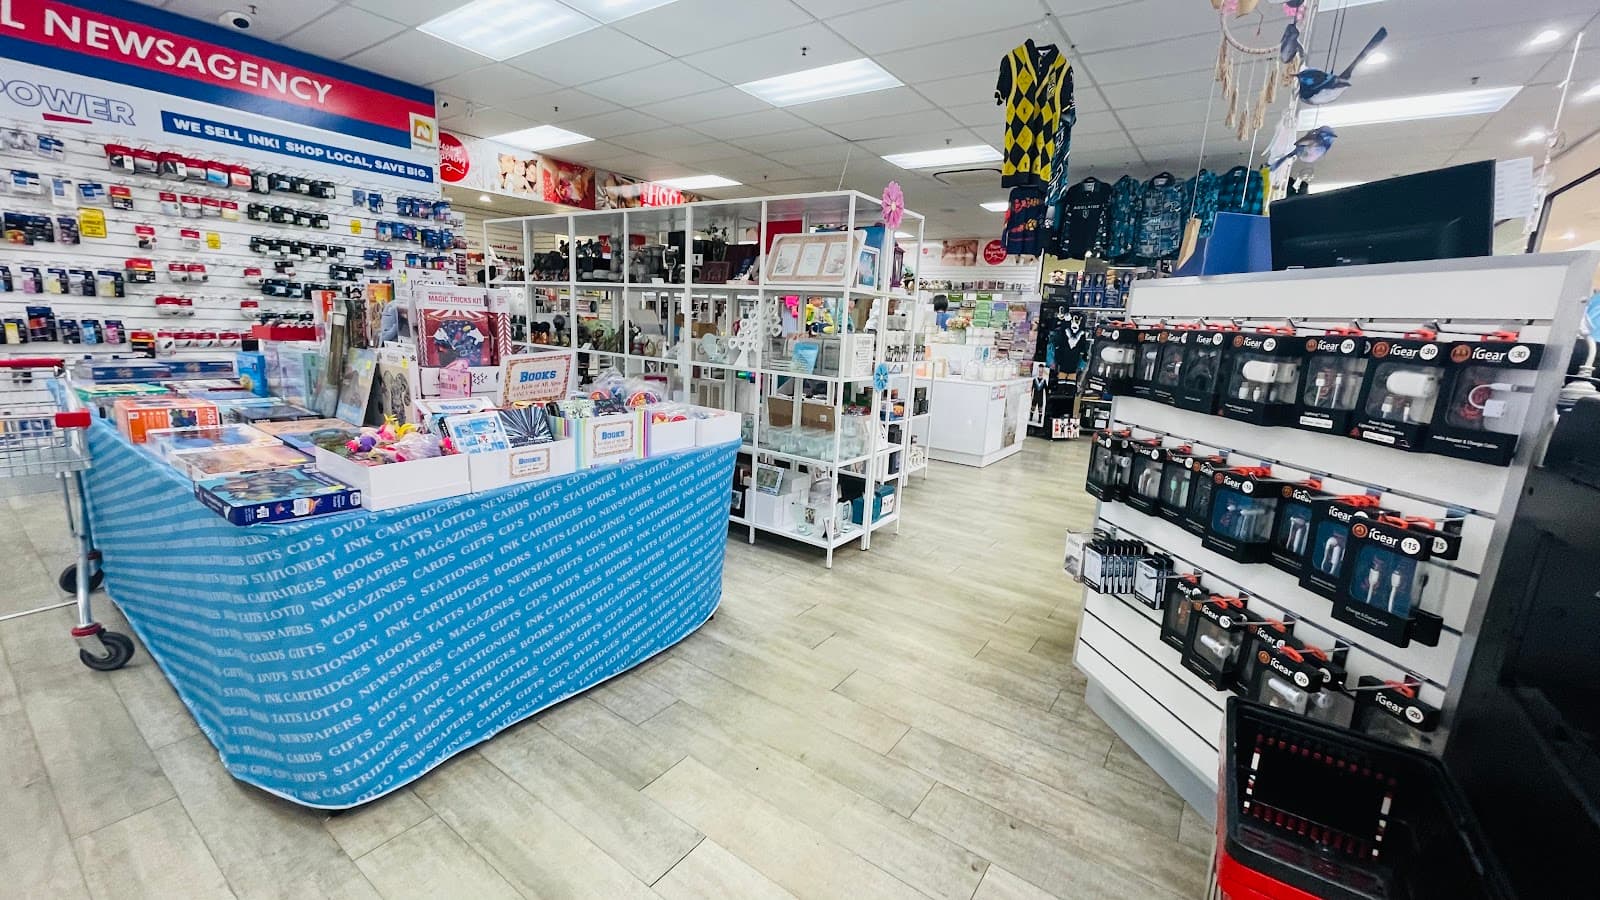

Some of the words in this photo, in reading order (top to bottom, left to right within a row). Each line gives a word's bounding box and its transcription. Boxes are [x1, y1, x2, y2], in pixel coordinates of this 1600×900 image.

[44, 8, 333, 104] NEWSAGENCY
[173, 117, 201, 133] WE
[204, 124, 243, 142] SELL
[248, 133, 280, 149] INK!
[285, 141, 322, 157] SHOP
[326, 149, 373, 168] LOCAL,
[374, 159, 405, 174] SAVE
[407, 166, 429, 178] BIG.
[450, 296, 472, 304] TRICKS
[1243, 337, 1262, 348] iGear
[1317, 339, 1339, 350] iGear
[1390, 345, 1418, 357] iGear
[1472, 347, 1506, 361] iGear
[1223, 476, 1241, 489] iGear
[1329, 505, 1352, 521] iGear
[246, 549, 281, 565] GIFTS
[287, 535, 325, 555] CD'S
[331, 513, 378, 538] DVD'S
[250, 650, 285, 663] CARDS
[289, 642, 326, 659] GIFTS
[333, 620, 368, 645] CD'S
[372, 594, 416, 623] DVD'S
[420, 552, 495, 597] STATIONERY
[500, 539, 521, 555] INK
[521, 505, 583, 543] CARTRIDGES
[587, 487, 617, 510] BOOKS
[621, 471, 643, 490] TATTS
[645, 459, 669, 477] LOTTO
[253, 549, 338, 584] STATIONERY
[344, 536, 373, 553] INK
[375, 499, 462, 539] CARTRIDGES
[265, 605, 305, 621] LOTTO
[311, 557, 408, 610] NEWSPAPERS
[414, 520, 488, 560] MAGAZINES
[492, 499, 530, 522] CARDS
[534, 484, 563, 502] GIFTS
[320, 577, 407, 628] MAGAZINES
[412, 552, 456, 579] CARDS
[460, 533, 495, 556] GIFTS
[498, 518, 524, 536] CD'S
[528, 502, 559, 522] DVD'S
[563, 471, 617, 504] STATIONERY
[332, 549, 385, 581] BOOKS
[390, 527, 432, 552] TATTS
[434, 508, 476, 532] LOTTO
[1369, 528, 1398, 547] iGear
[283, 664, 371, 702] CARTRIDGES
[376, 632, 422, 666] BOOKS
[426, 607, 465, 633] TATTS
[466, 585, 503, 611] LOTTO
[508, 544, 573, 586] NEWSPAPERS
[576, 514, 626, 548] MAGAZINES
[628, 498, 654, 517] CARDS
[656, 485, 678, 500] GIFTS
[679, 473, 695, 486] CD'S
[696, 462, 716, 477] DVD'S
[292, 635, 380, 681] STATIONERY
[385, 618, 410, 638] INK
[412, 574, 490, 621] CARTRIDGES
[494, 550, 531, 577] BOOKS
[536, 534, 565, 553] TATTS
[566, 515, 596, 536] LOTTO
[600, 485, 651, 518] NEWSPAPERS
[654, 461, 695, 485] MAGAZINES
[305, 698, 353, 721] LOTTO
[359, 638, 444, 698] NEWSPAPERS
[449, 596, 515, 640] MAGAZINES
[519, 574, 553, 598] CARDS
[556, 555, 583, 576] GIFTS
[586, 542, 606, 557] CD'S
[608, 524, 634, 544] DVD'S
[636, 496, 680, 527] STATIONERY
[682, 487, 695, 499] INK
[368, 658, 443, 714] MAGAZINES
[447, 631, 486, 659] CARDS
[490, 610, 522, 632] GIFTS
[525, 593, 549, 611] CD'S
[551, 573, 581, 595] DVD'S
[584, 539, 634, 576] STATIONERY
[636, 529, 650, 542] INK
[651, 502, 694, 532] CARTRIDGES
[1202, 604, 1219, 620] iGear
[1257, 627, 1275, 644] iGear
[328, 728, 373, 757] GIFTS
[378, 702, 408, 728] CD'S
[412, 673, 450, 704] DVD'S
[453, 627, 521, 675] STATIONERY
[525, 613, 545, 628] INK
[545, 576, 602, 615] CARTRIDGES
[605, 556, 633, 577] BOOKS
[635, 540, 658, 557] TATTS
[658, 524, 681, 543] LOTTO
[333, 714, 417, 776] STATIONERY
[423, 696, 445, 715] INK
[446, 648, 517, 697] CARTRIDGES
[519, 623, 554, 649] BOOKS
[557, 602, 586, 623] TATTS
[586, 583, 614, 605] LOTTO
[617, 549, 665, 584] NEWSPAPERS
[667, 520, 705, 550] MAGAZINES
[476, 699, 512, 728] CARDS
[515, 677, 545, 700] GIFTS
[573, 638, 600, 661] DVD'S
[602, 602, 649, 640] STATIONERY
[568, 639, 620, 680] CARTRIDGES
[622, 616, 648, 639] BOOKS
[605, 644, 630, 667] LOTTO
[632, 606, 677, 643] NEWSPAPERS
[1270, 657, 1293, 677] iGear
[322, 741, 409, 798] CARTRIDGES
[413, 707, 455, 742] BOOKS
[458, 681, 493, 706] TATTS
[494, 656, 529, 682] LOTTO
[532, 613, 592, 657] NEWSPAPERS
[595, 579, 641, 614] MAGAZINES
[643, 561, 667, 580] CARDS
[669, 547, 688, 562] GIFTS
[356, 774, 394, 802] OTTO
[397, 710, 474, 773] NEWSPAPERS
[478, 665, 539, 712] MAGAZINES
[542, 640, 574, 666] CARDS
[577, 622, 602, 642] GIFTS
[605, 605, 623, 623] CD'S
[625, 588, 648, 608] DVD'S
[650, 557, 691, 590] STATIONERY
[1376, 692, 1404, 714] iGear
